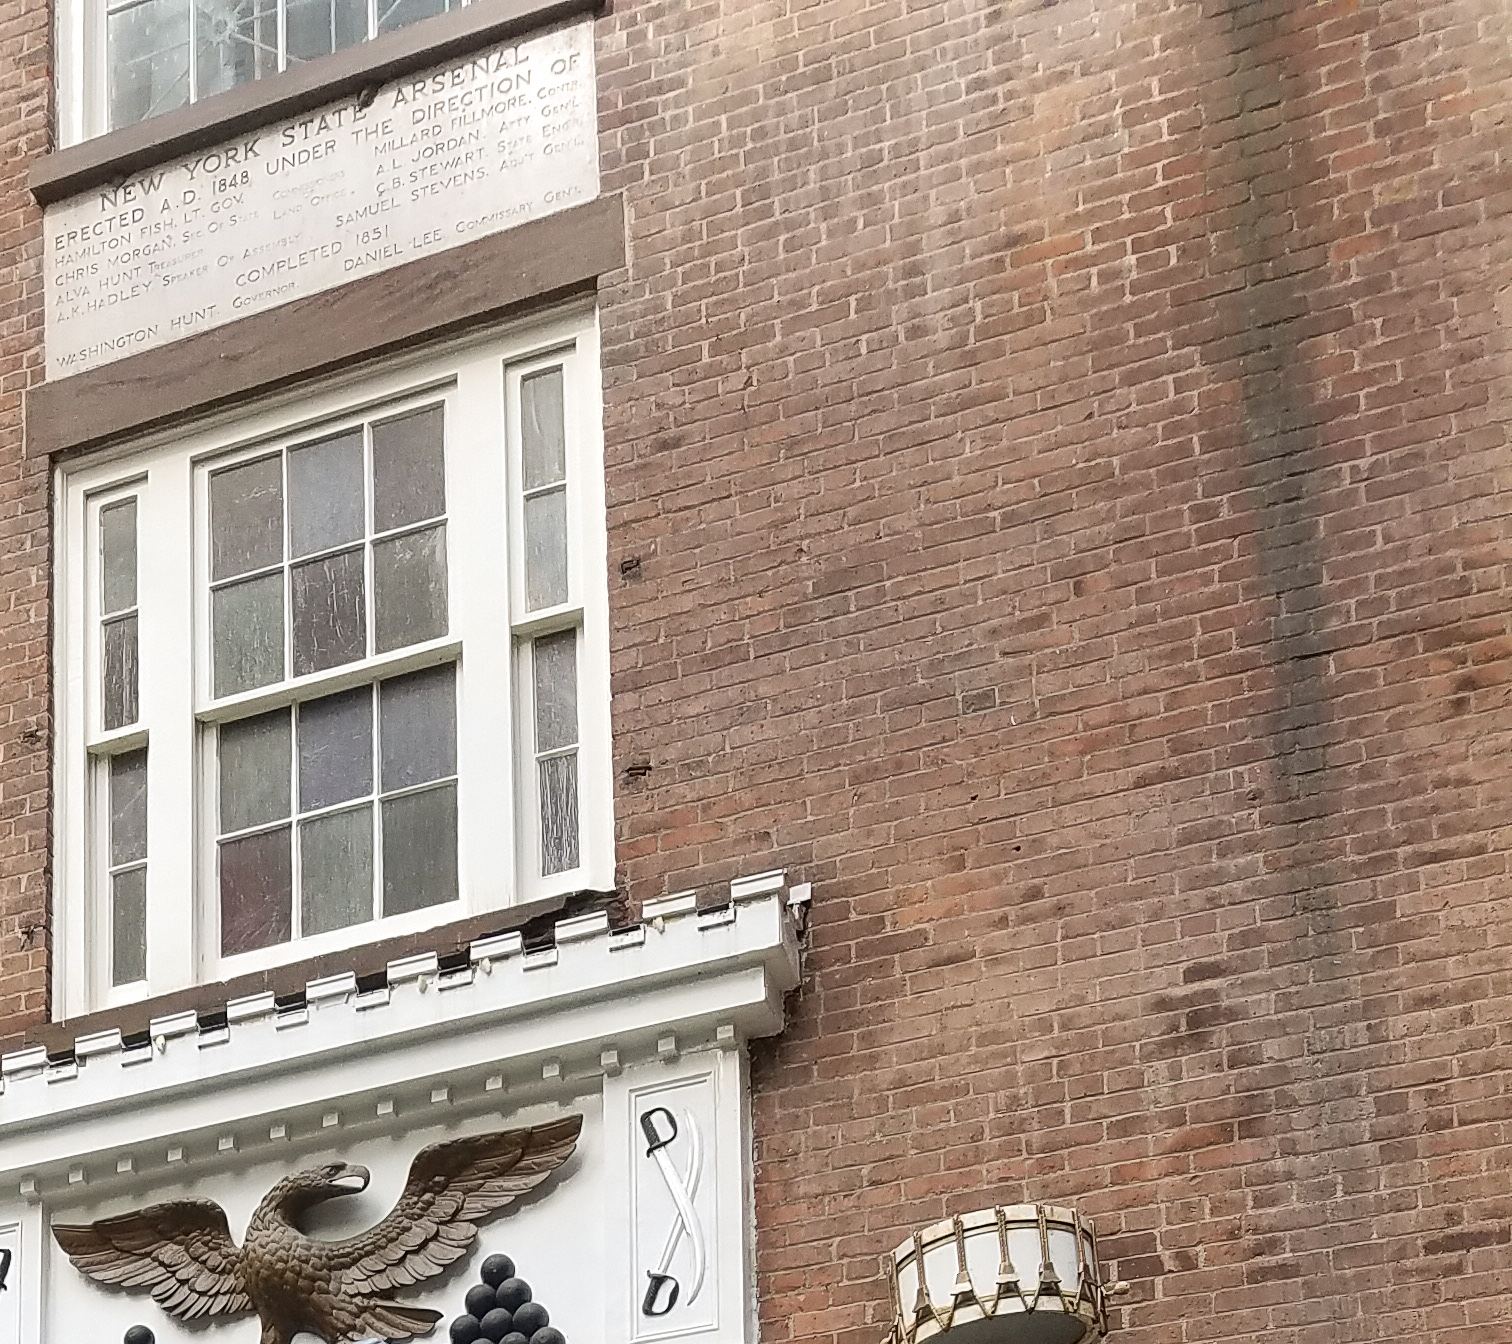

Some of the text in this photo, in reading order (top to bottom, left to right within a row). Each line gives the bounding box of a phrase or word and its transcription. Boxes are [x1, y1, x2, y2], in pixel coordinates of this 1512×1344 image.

[54, 207, 145, 251] ERECTED
[211, 170, 250, 196] 1848
[266, 139, 337, 176] UNDER
[351, 118, 394, 145] THE
[412, 69, 532, 125] DIRECTION
[550, 52, 581, 75] OF
[100, 46, 530, 212] NEW YORK STATE ARSENAL
[374, 124, 442, 157] MILLARD
[451, 93, 532, 131] FILLMORE.
[335, 197, 401, 228] SAMUEL
[410, 166, 489, 202] STEVENS.
[54, 231, 132, 268] HAMILTON
[184, 208, 206, 224] LT.
[210, 192, 244, 214] GOV.
[235, 224, 388, 287] COMPLETED 1851
[344, 243, 403, 272] DANIEL
[455, 201, 533, 233] COMMISSARY
[55, 262, 99, 287] CHRIS
[55, 285, 91, 307] ALVA
[99, 266, 142, 291] HUNT
[162, 263, 209, 287] SPEAKER
[217, 254, 235, 267] OF
[56, 324, 159, 367] WASHINGTON
